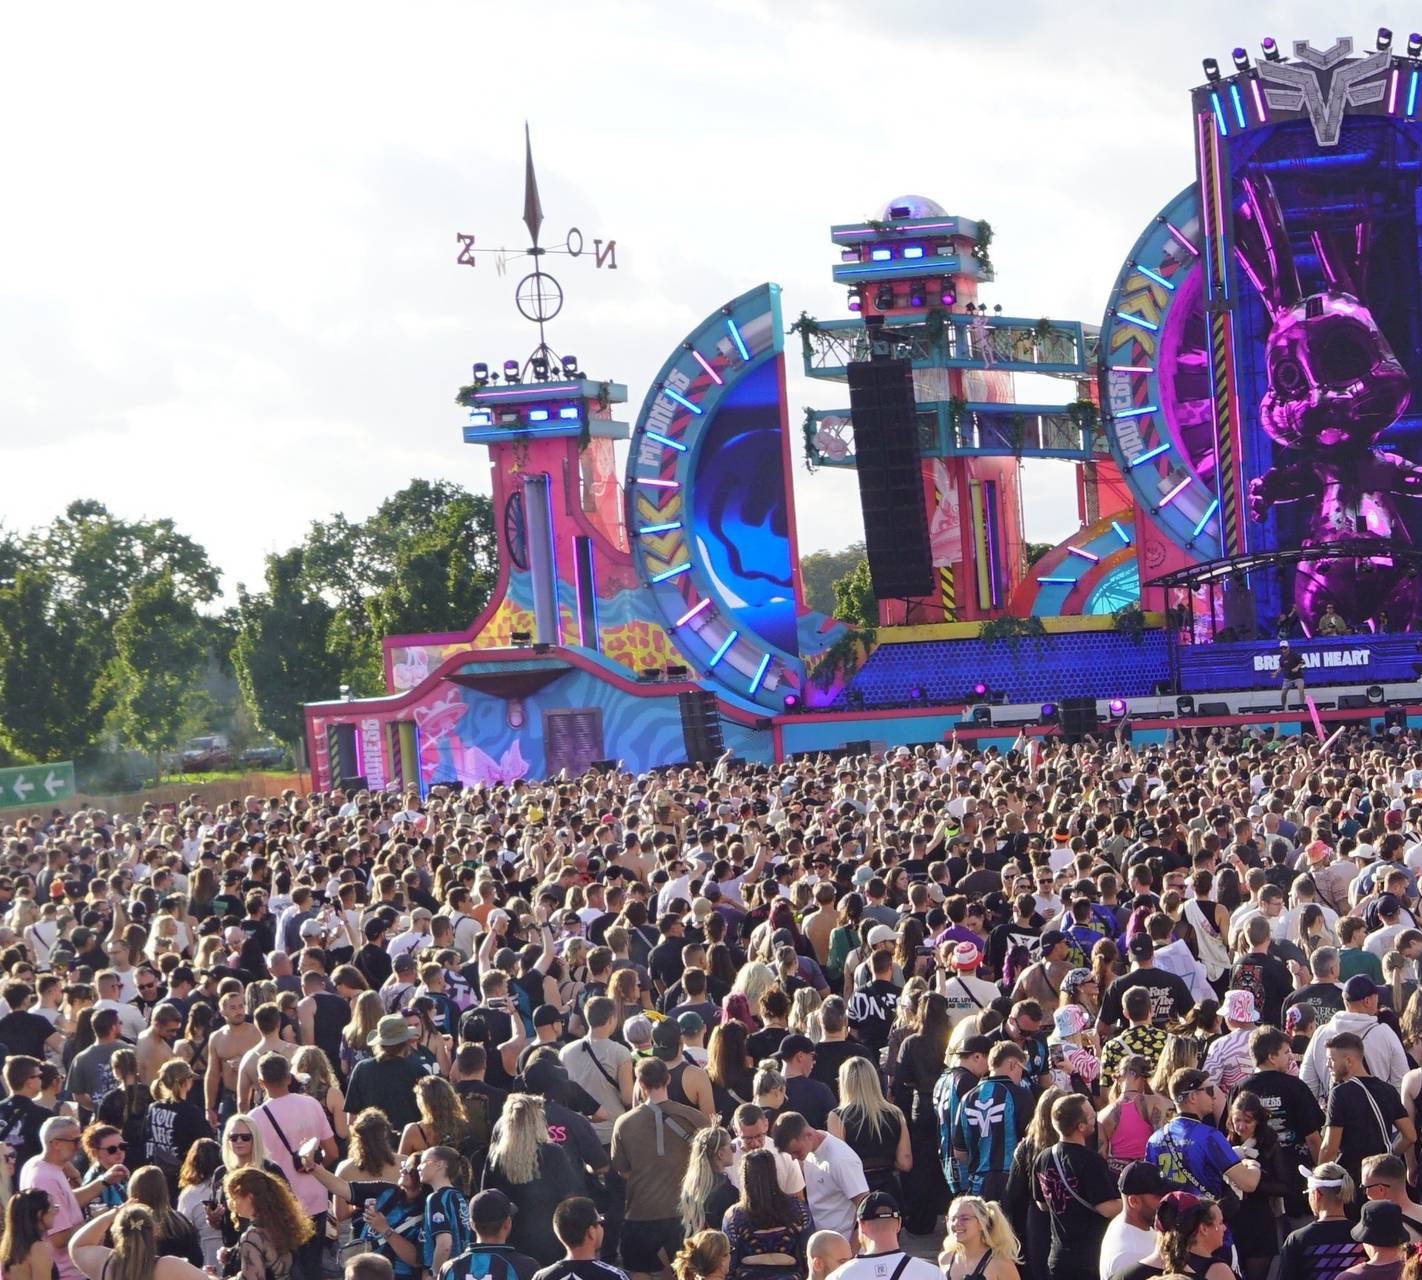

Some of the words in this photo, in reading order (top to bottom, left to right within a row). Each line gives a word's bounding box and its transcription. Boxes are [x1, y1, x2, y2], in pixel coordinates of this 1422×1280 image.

[567, 227, 583, 257] O
[638, 368, 690, 466] MDNES
[1108, 370, 1144, 467] MADESS
[1254, 653, 1320, 671] BREAN
[1323, 650, 1370, 667] HEART
